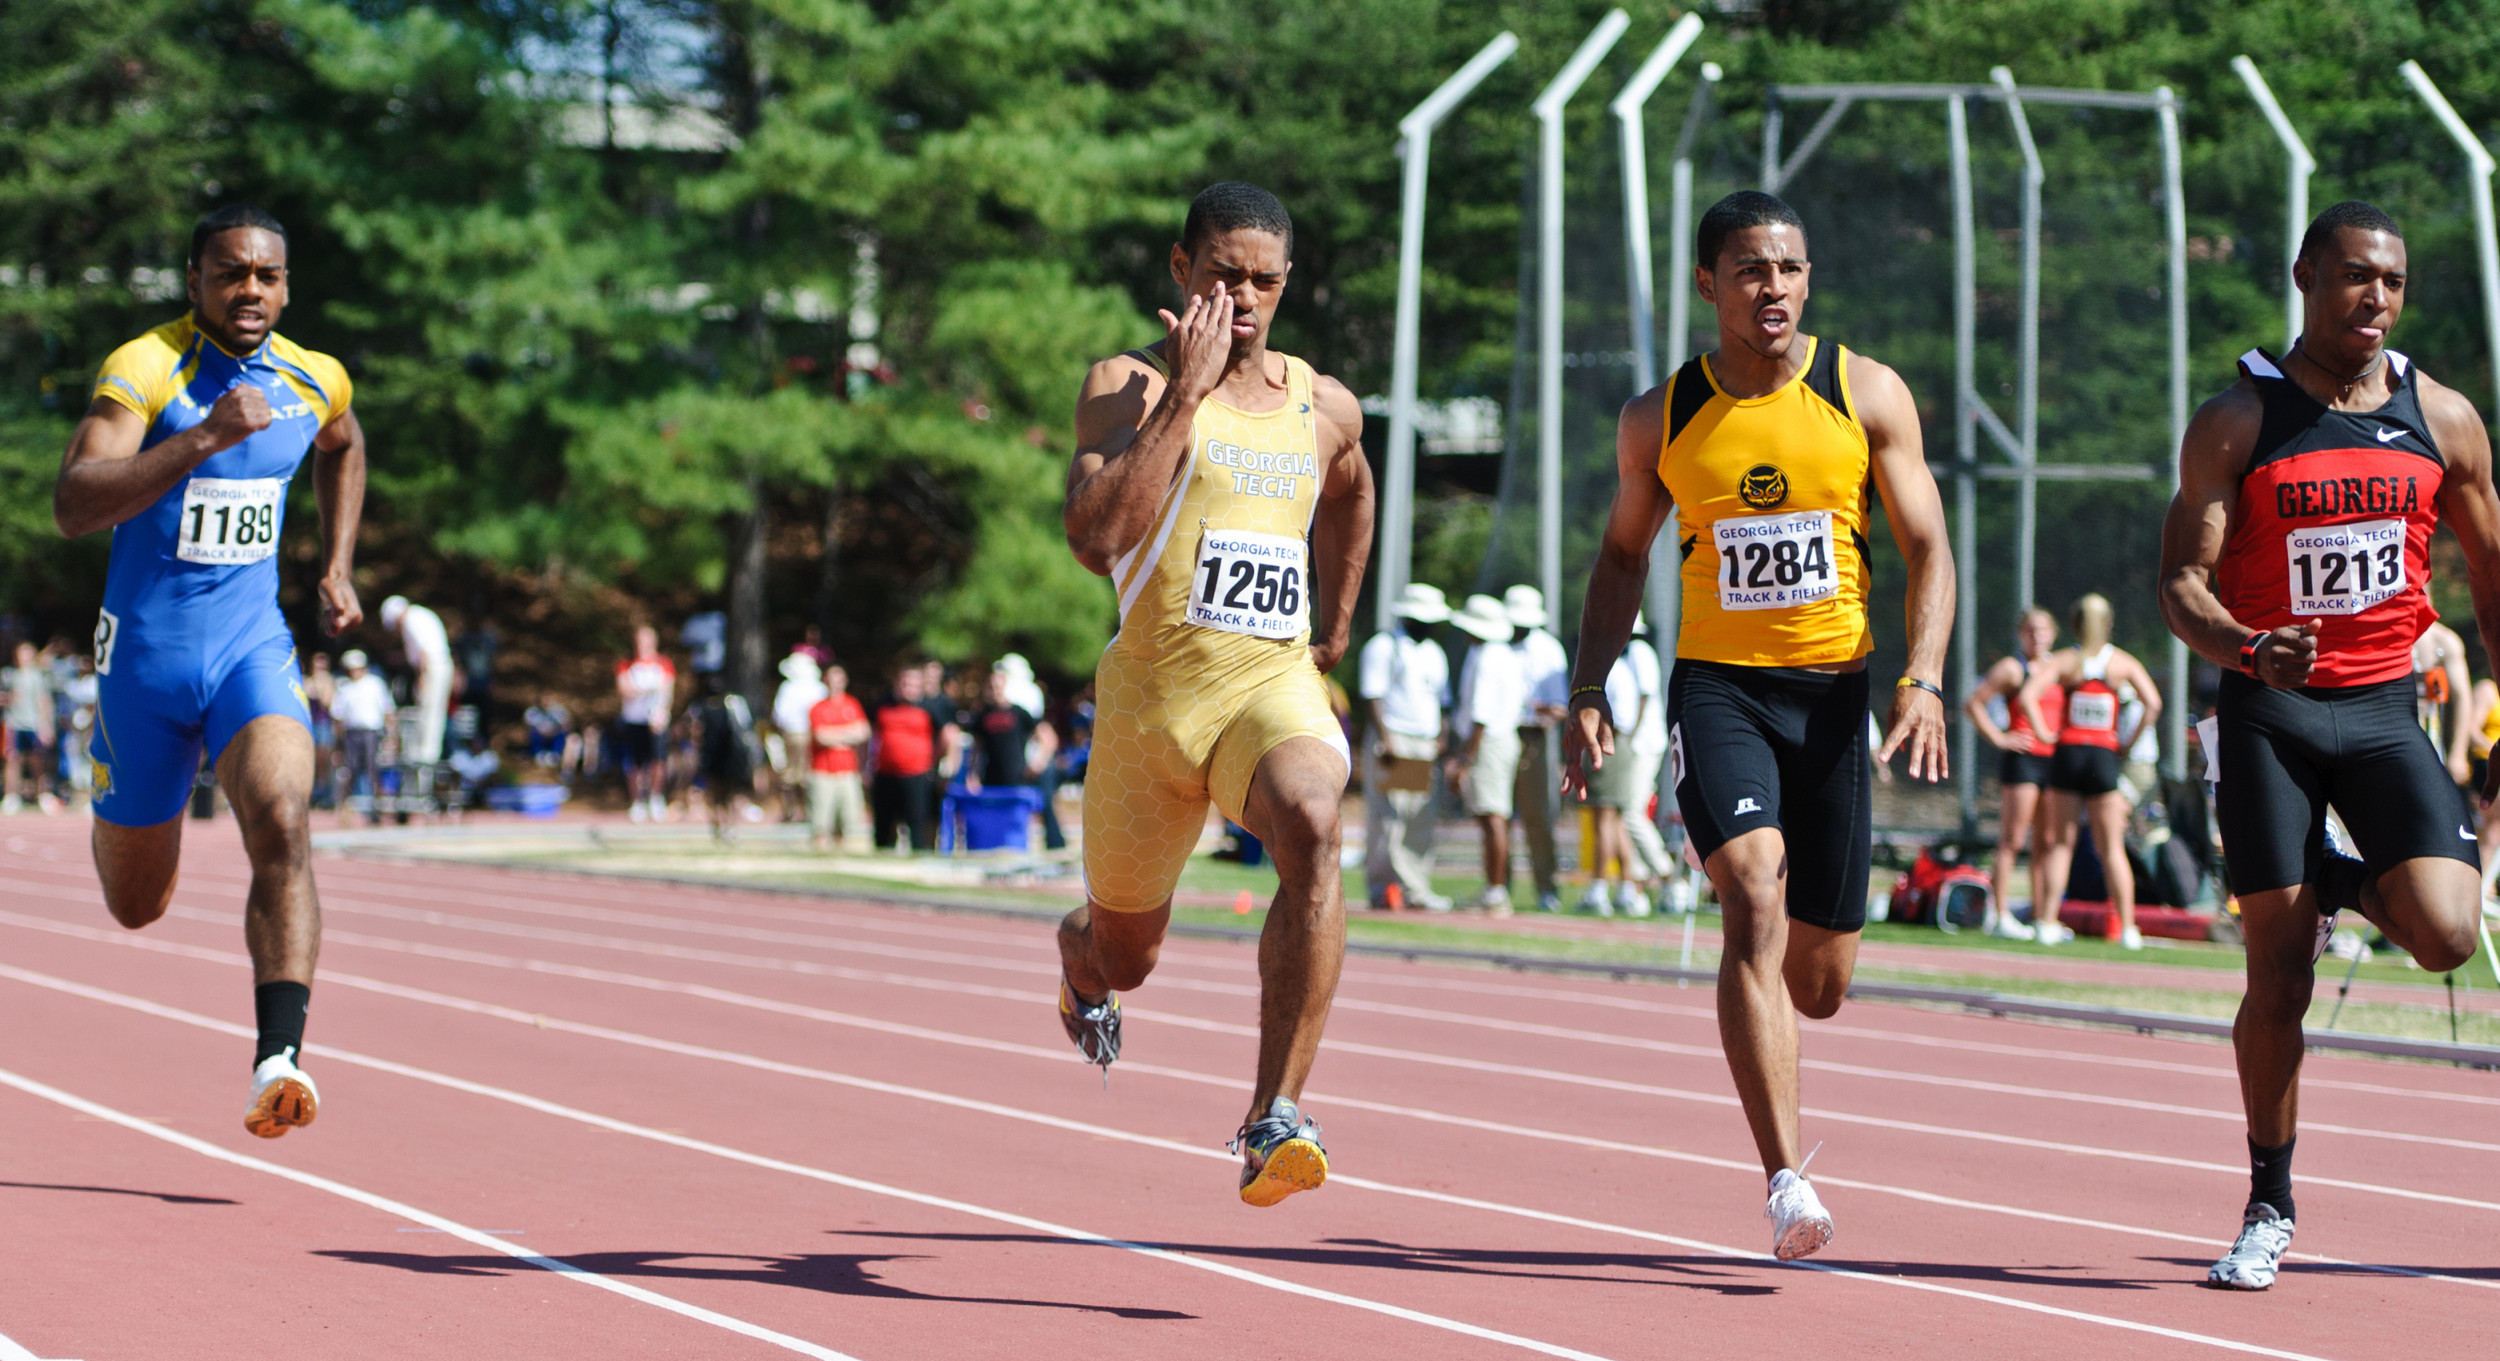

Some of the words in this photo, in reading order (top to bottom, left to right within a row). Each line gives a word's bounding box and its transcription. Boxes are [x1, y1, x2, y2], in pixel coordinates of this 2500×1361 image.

[1207, 439, 1316, 478] GEORGIA
[192, 487, 247, 499] GEORGIA
[1232, 471, 1296, 499] TECH
[2276, 477, 2419, 519] GEORGIA
[189, 504, 272, 545] 1189
[1720, 525, 1783, 539] GEORGIA
[1787, 520, 1822, 533] TECH
[1209, 539, 1271, 556] GEORGIA
[1275, 547, 1299, 560] TECH
[2294, 534, 2360, 548] GEORGIA
[2364, 529, 2398, 543] TECH
[186, 548, 225, 559] TRACK
[1722, 536, 1830, 588] 1284
[2293, 543, 2400, 597] 1213
[1201, 556, 1299, 616] 1256
[1728, 592, 1771, 604] TRACK
[1776, 591, 1786, 601] &
[1792, 586, 1828, 600] FIELD
[2300, 599, 2345, 609] TRACK
[2351, 597, 2359, 608] &
[2364, 589, 2397, 604] FIELD
[1196, 607, 1242, 626] TRACK
[1247, 616, 1257, 627] &
[1262, 619, 1294, 631] FIELD
